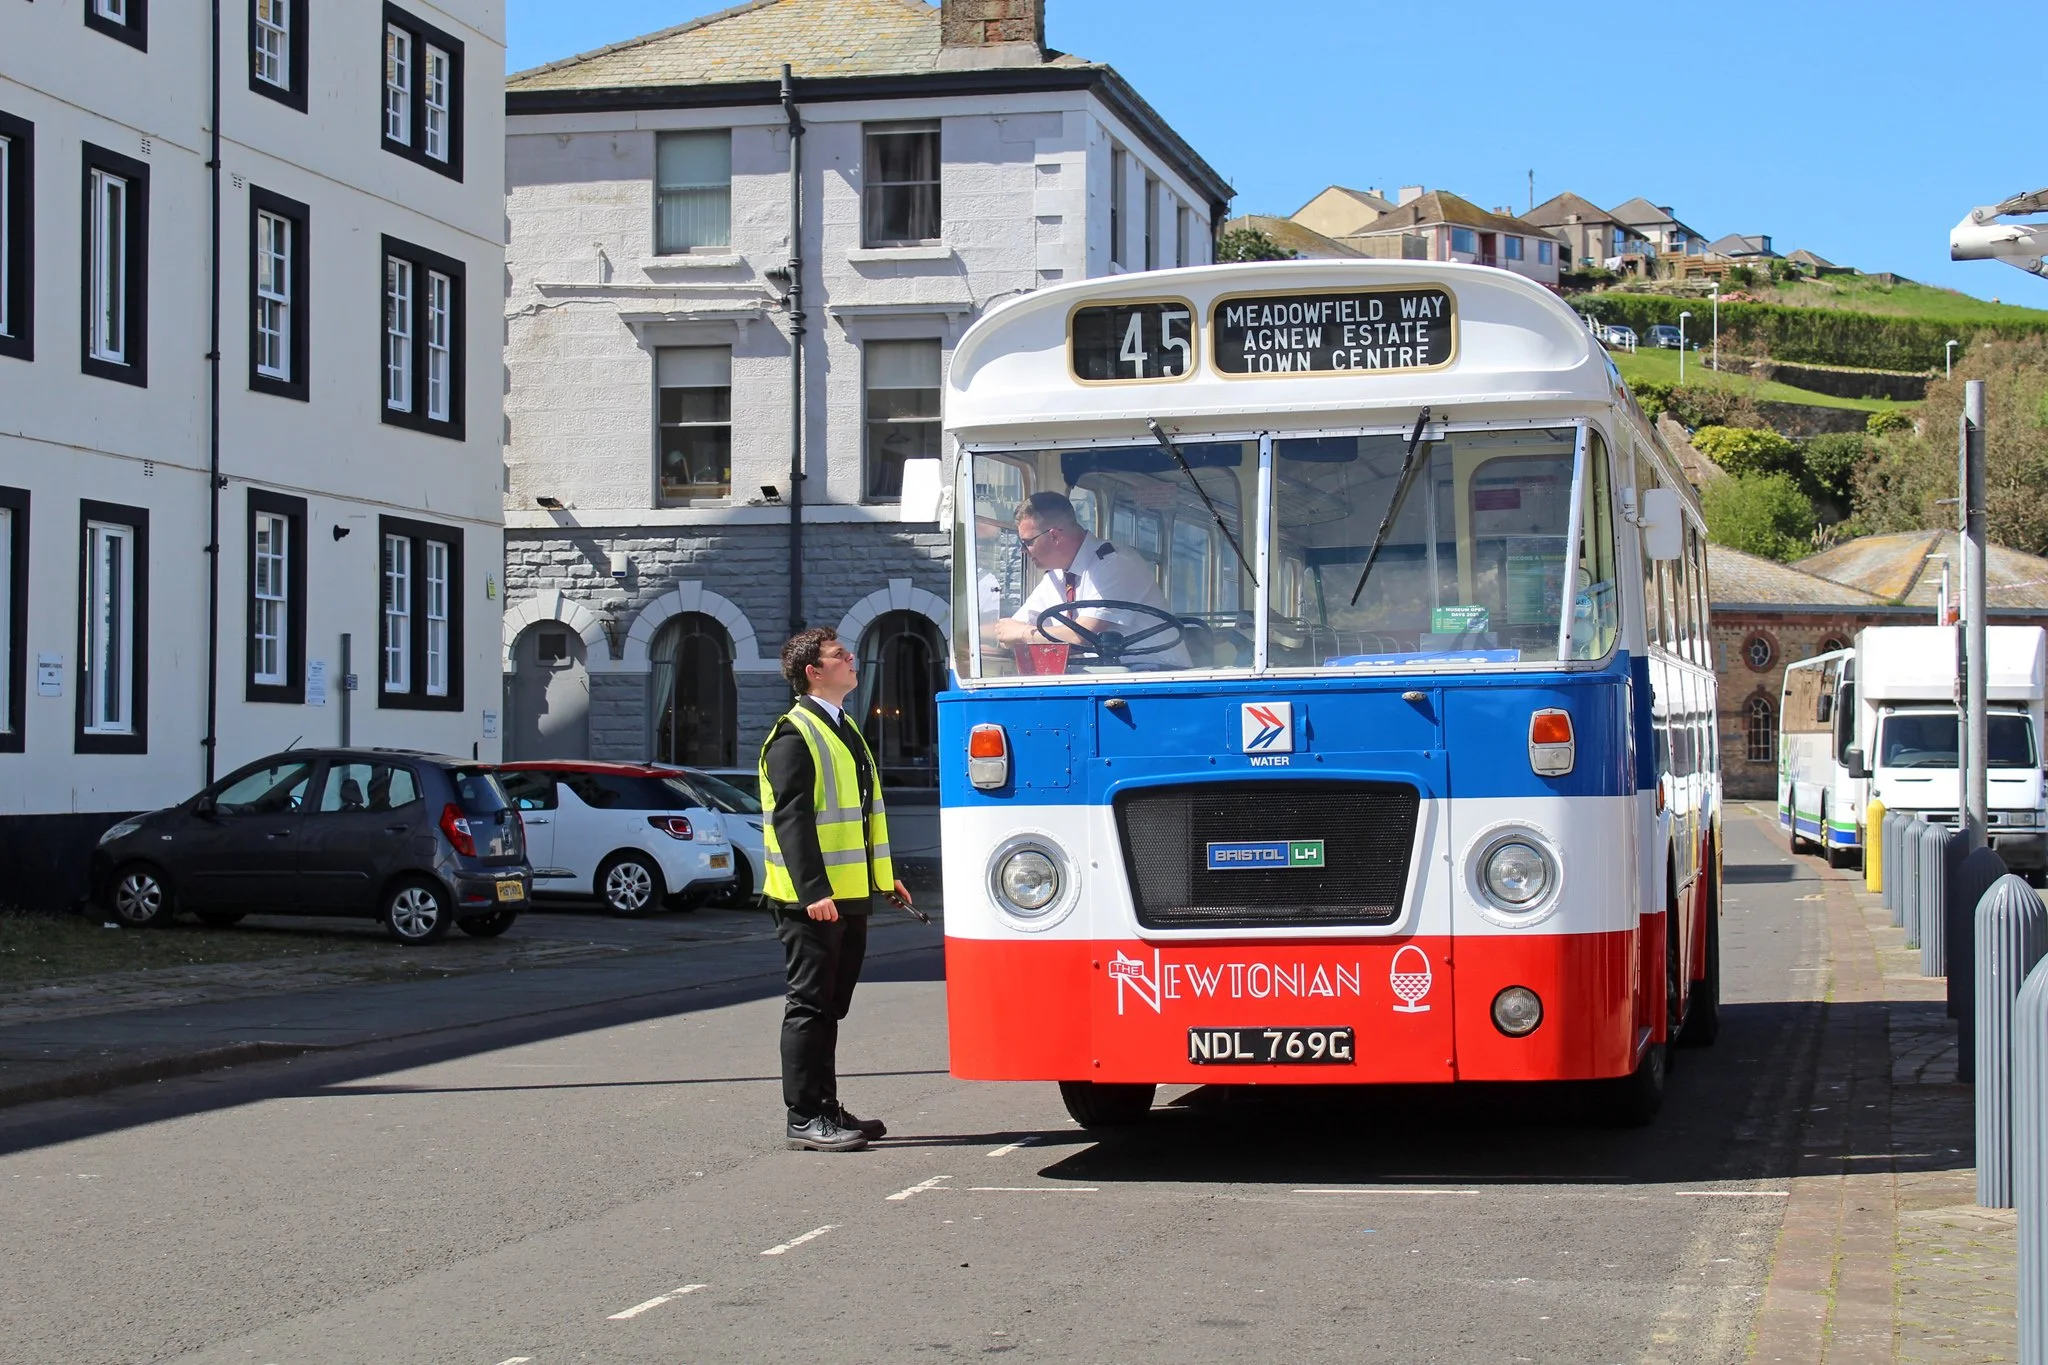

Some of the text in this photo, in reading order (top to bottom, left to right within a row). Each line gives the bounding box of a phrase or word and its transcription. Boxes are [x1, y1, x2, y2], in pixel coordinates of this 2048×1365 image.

[1226, 295, 1444, 328] MEADOWFIELD WAY
[1119, 310, 1192, 379] 45
[1243, 320, 1430, 351] AGNEW ESTATE
[1243, 345, 1430, 374] TOWN CENTRE
[1250, 756, 1290, 767] WATER
[1215, 848, 1317, 862] BRISTOL LH
[1113, 962, 1140, 976] THE
[1191, 1031, 1350, 1060] NDL 769G
